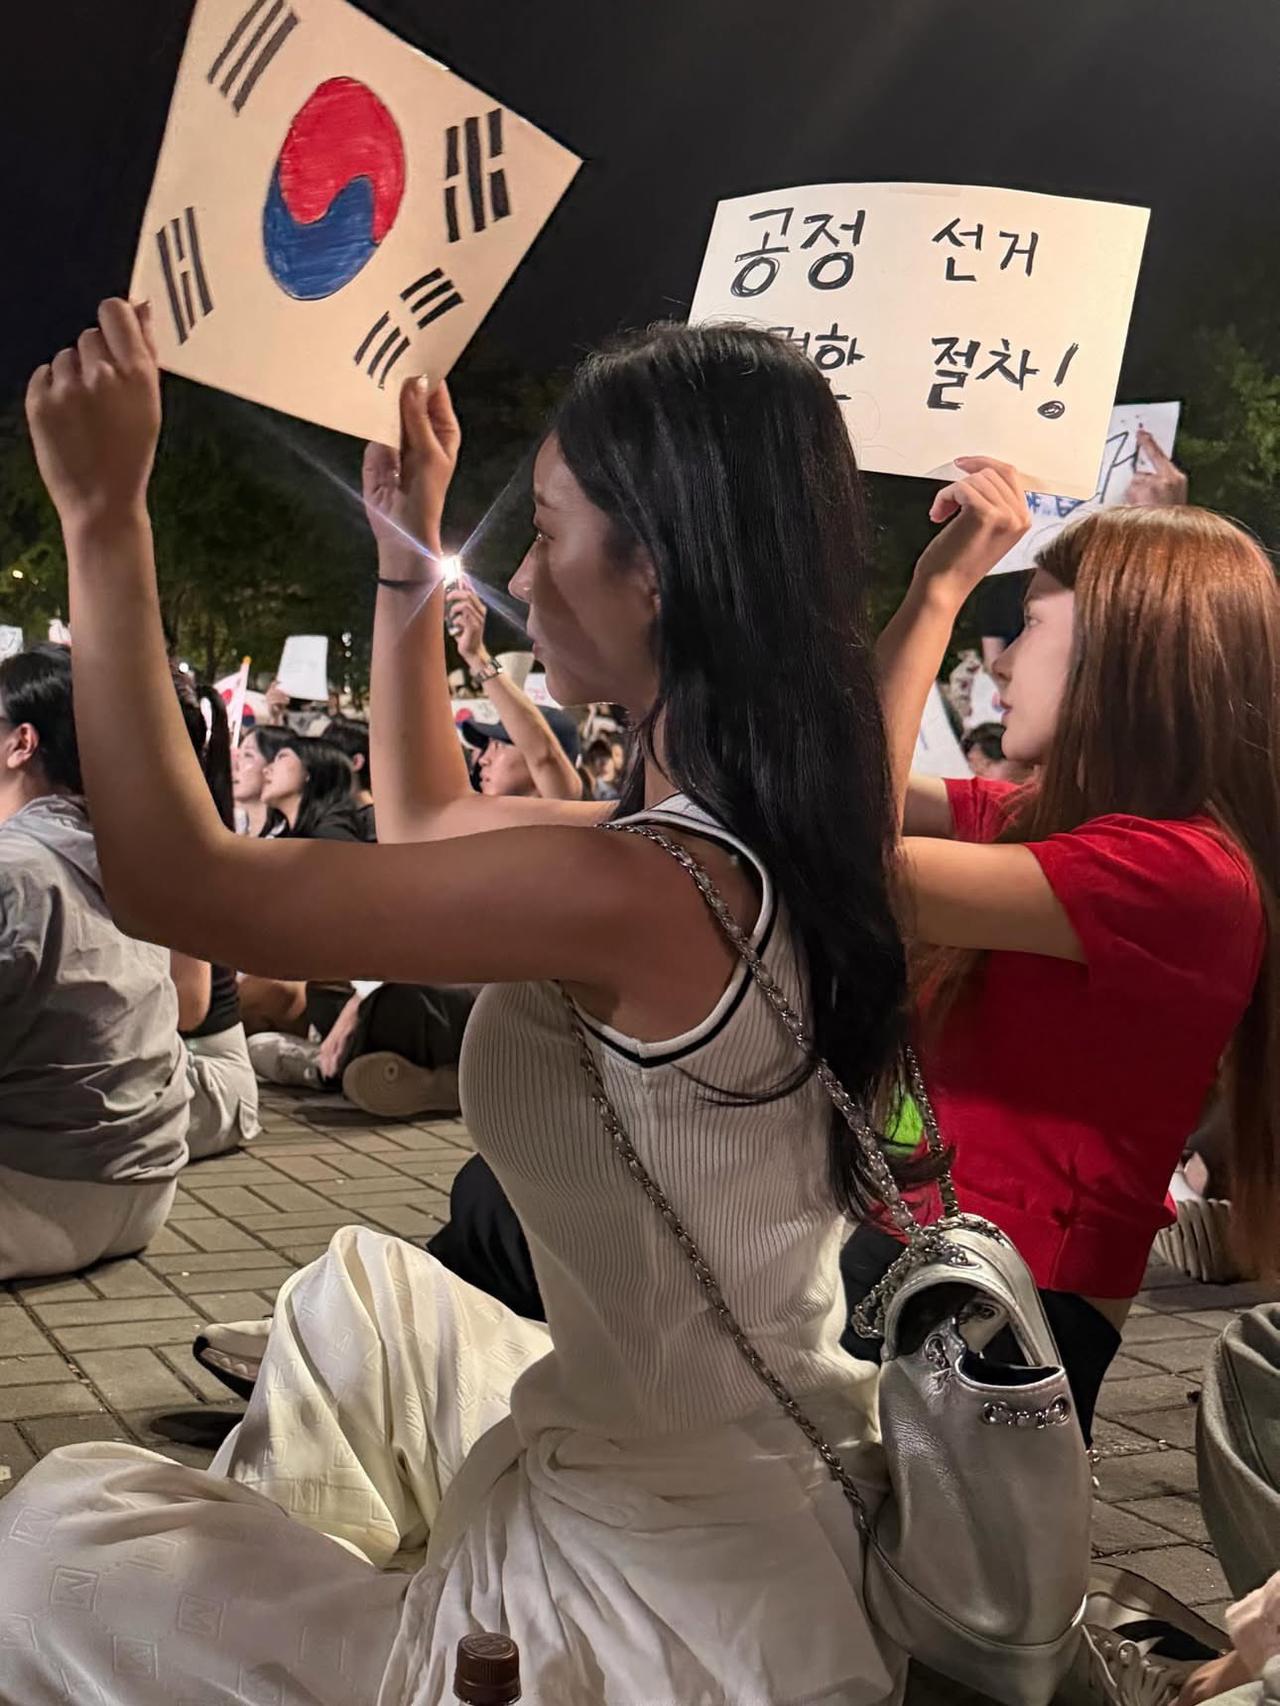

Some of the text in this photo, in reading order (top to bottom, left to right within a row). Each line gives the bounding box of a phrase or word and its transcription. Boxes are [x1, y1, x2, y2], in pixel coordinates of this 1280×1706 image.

[731, 207, 1039, 298] 공정 선거
[926, 337, 1079, 420] 절차!
